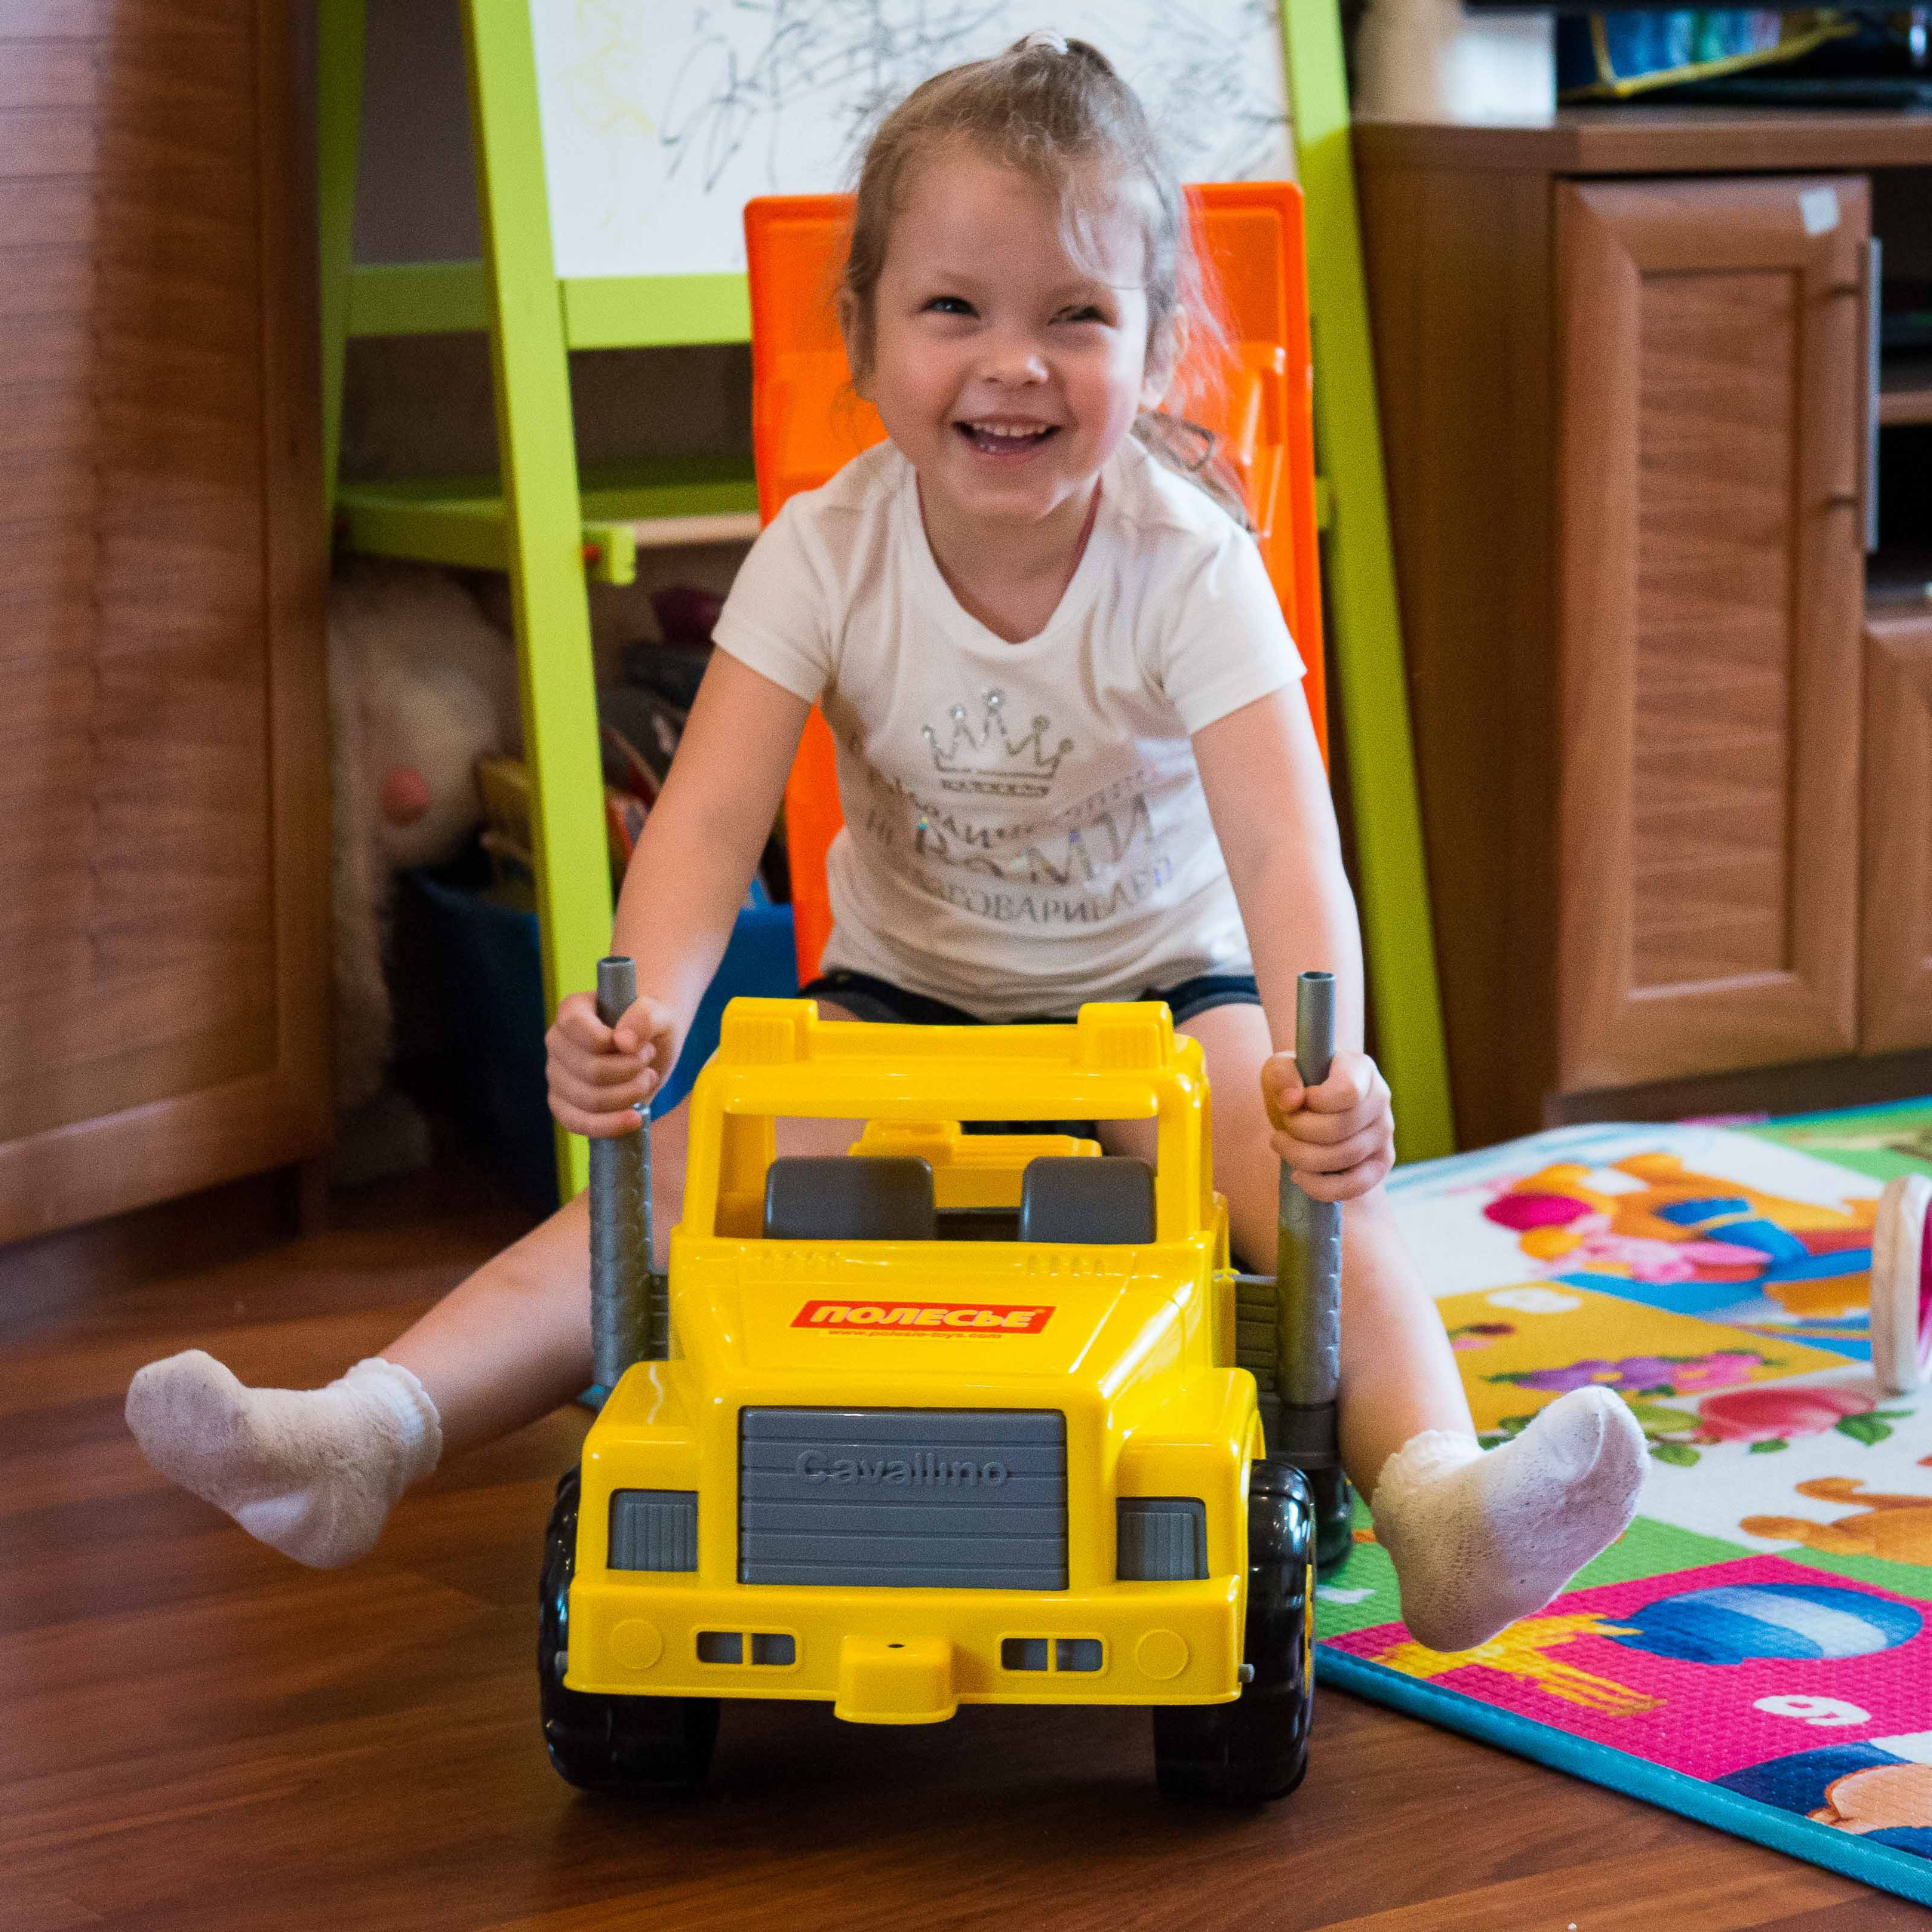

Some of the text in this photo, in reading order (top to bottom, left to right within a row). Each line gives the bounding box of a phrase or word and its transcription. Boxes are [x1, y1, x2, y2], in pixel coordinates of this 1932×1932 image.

[809, 1306, 1036, 1328] ПОЛЕСЬЕ
[828, 1330, 1002, 1339] www.polesie-toys.com
[795, 1450, 1008, 1488] Cavallino
